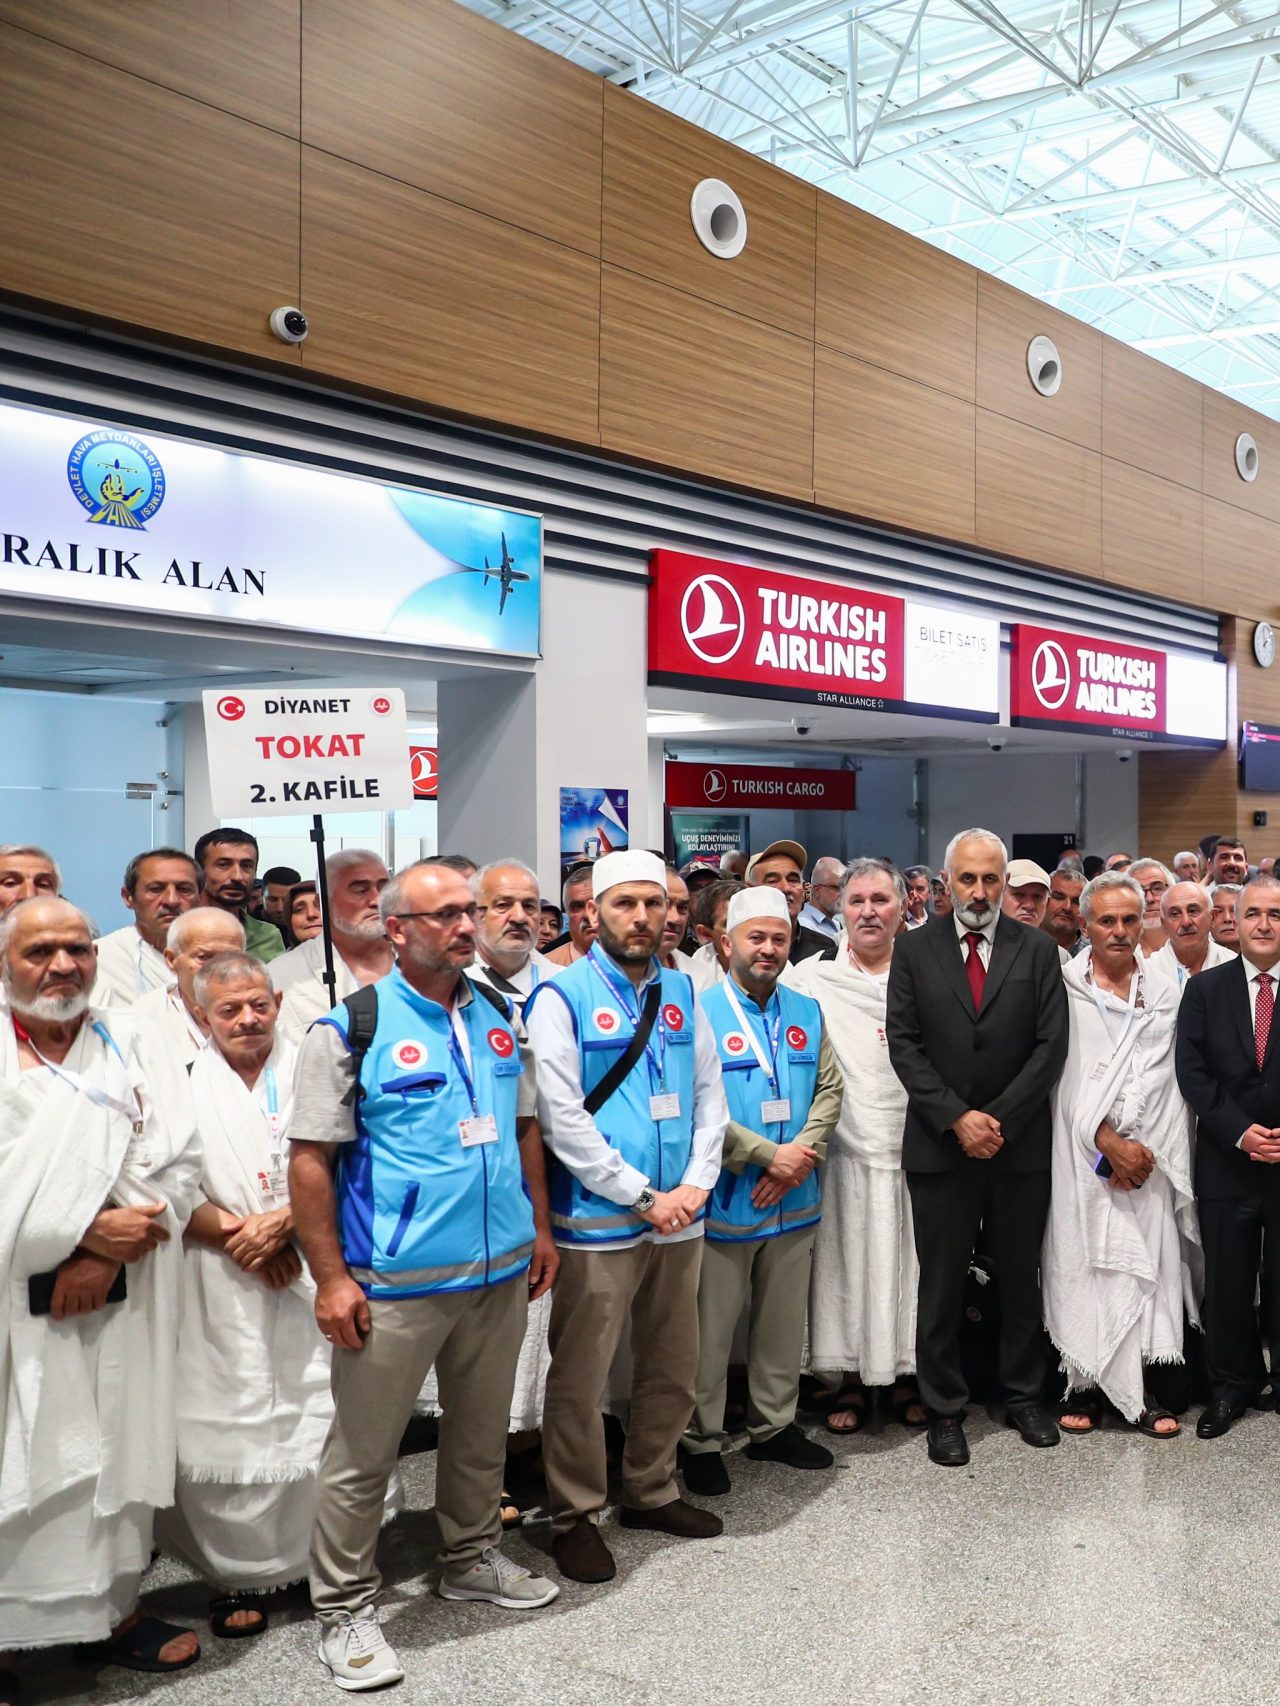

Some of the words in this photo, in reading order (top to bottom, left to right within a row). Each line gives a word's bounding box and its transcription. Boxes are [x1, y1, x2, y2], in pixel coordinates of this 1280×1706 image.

[72, 439, 93, 465] HAVA
[70, 467, 95, 508] DEVLET
[161, 557, 267, 597] ALAN
[757, 587, 887, 645] TURKISH
[755, 630, 887, 684] AIRLINES
[1076, 648, 1156, 690] TURKISH
[264, 696, 351, 715] DİYANET
[817, 692, 838, 703] STAR
[839, 695, 877, 708] ALLIANCE
[1075, 681, 1157, 720] AIRLINES
[1112, 727, 1125, 737] STAR
[255, 733, 366, 760] TOKAT
[250, 783, 276, 804] 2.
[283, 775, 380, 802] KAFİLE
[731, 779, 783, 795] TURKISH
[786, 781, 825, 796] CARGO
[681, 834, 699, 844] UÇUŞ
[1063, 835, 1073, 845] 21
